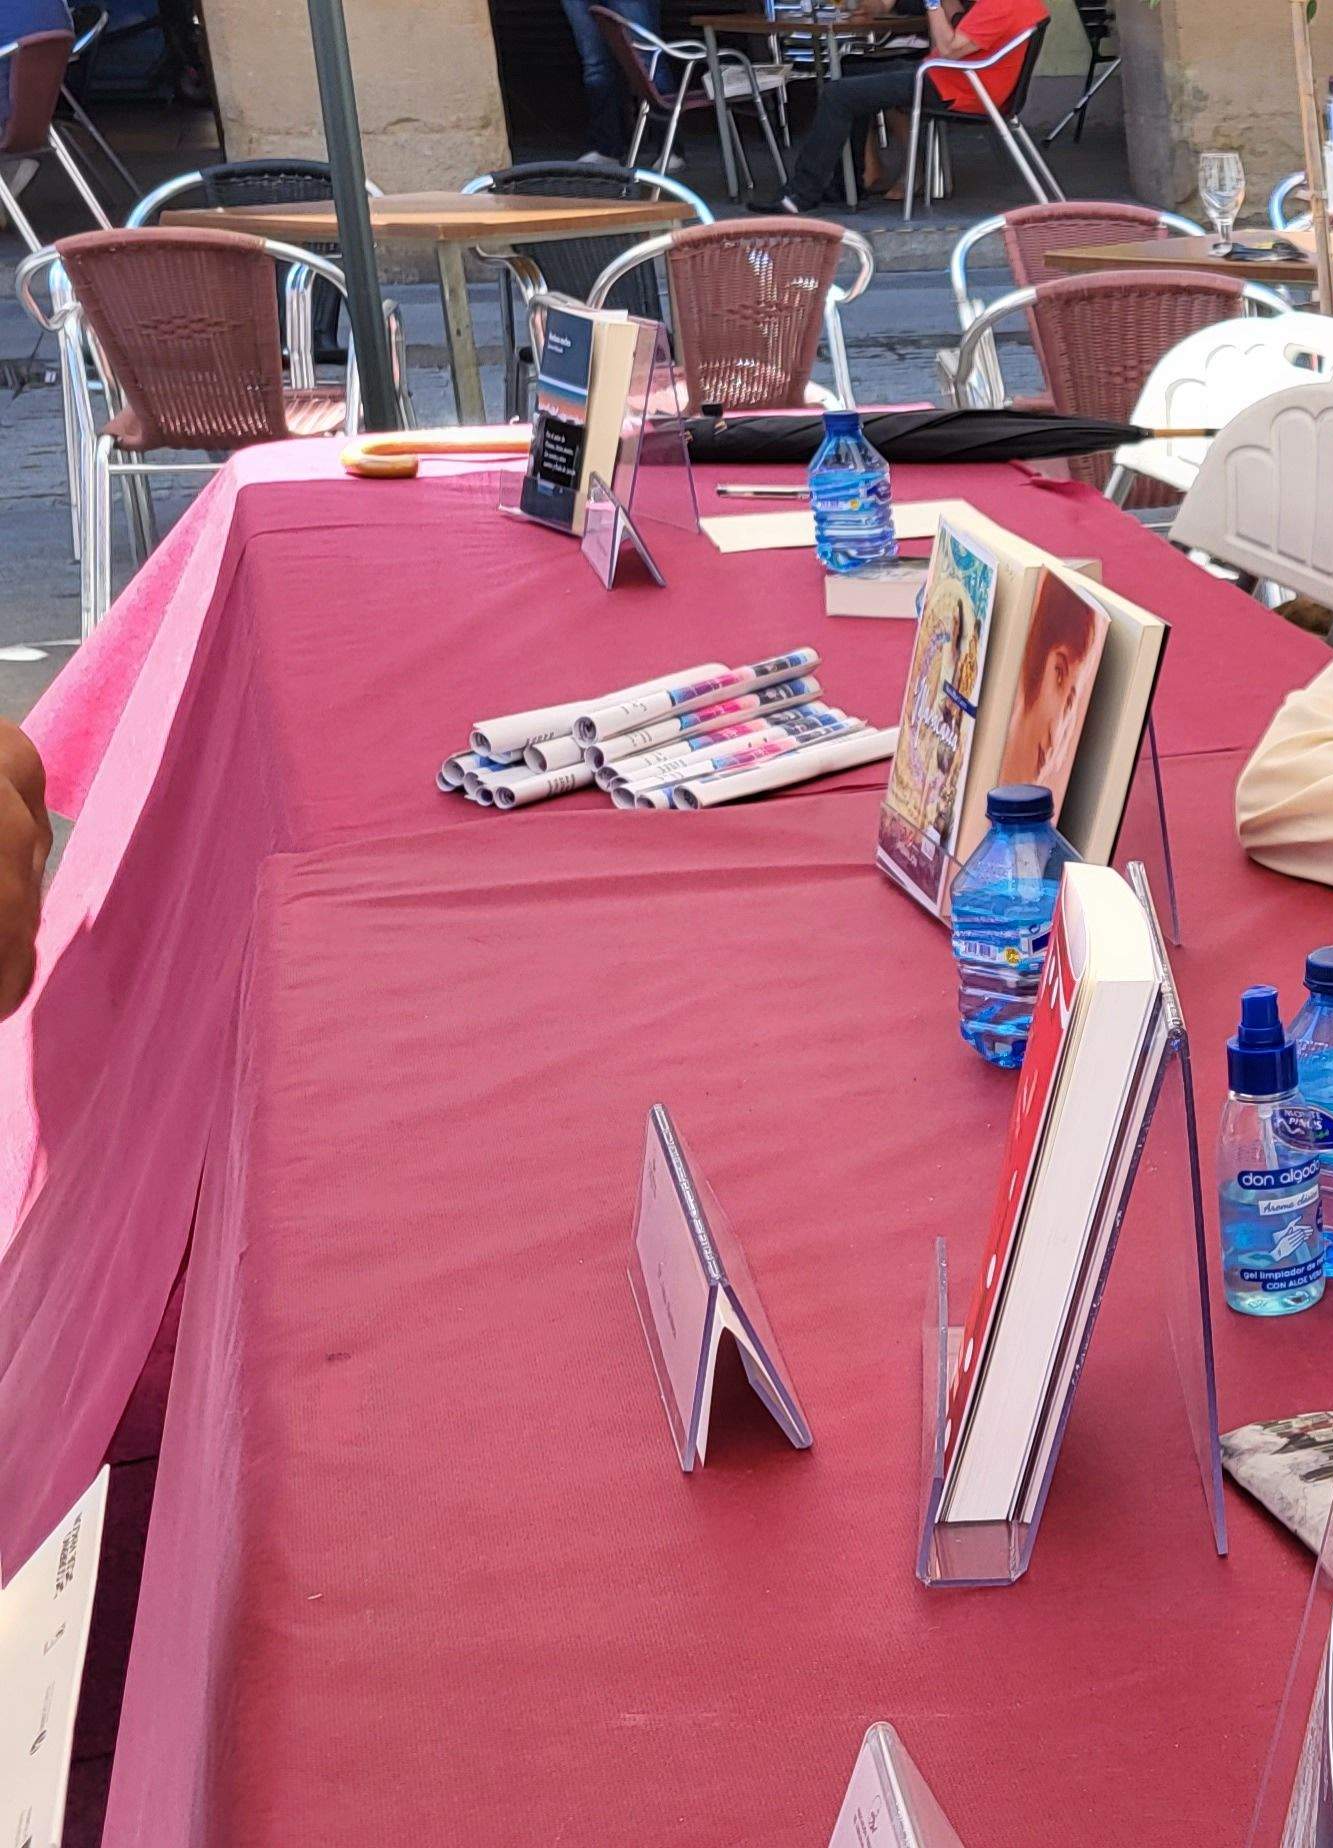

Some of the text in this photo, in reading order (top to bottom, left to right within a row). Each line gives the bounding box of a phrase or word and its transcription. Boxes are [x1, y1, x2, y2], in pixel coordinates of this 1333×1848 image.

[1242, 1172, 1275, 1186] don
[1264, 1202, 1294, 1213] Aroma
[1243, 1271, 1257, 1280] gel
[1260, 1265, 1304, 1280] limpiador
[1267, 1281, 1286, 1290] CON
[1289, 1277, 1308, 1288] ALOE
